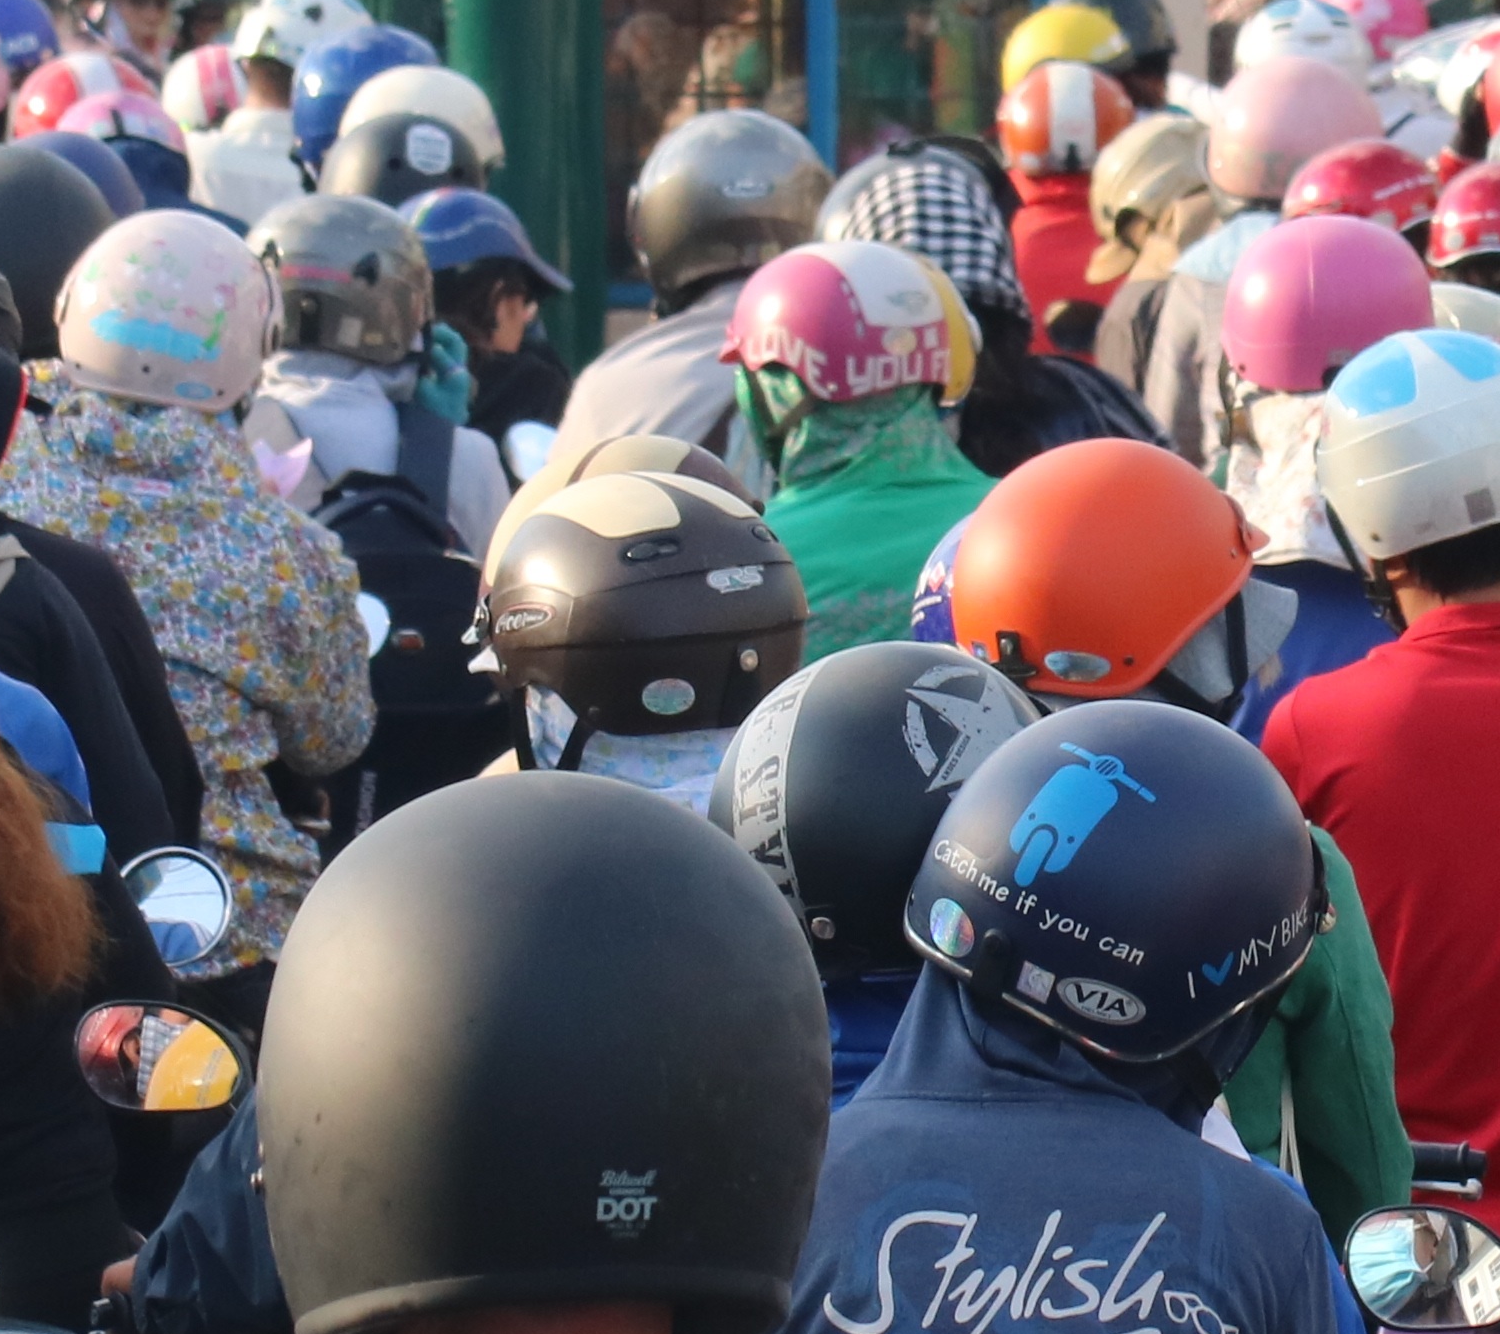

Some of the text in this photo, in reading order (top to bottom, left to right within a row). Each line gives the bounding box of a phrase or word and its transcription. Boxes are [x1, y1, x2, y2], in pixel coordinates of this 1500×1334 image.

[933, 838, 1146, 966] Catch me if you can
[1237, 924, 1279, 977] MY
[1280, 896, 1311, 949] BIKE
[1073, 982, 1129, 1019] VIA
[597, 1196, 660, 1221] DOT
